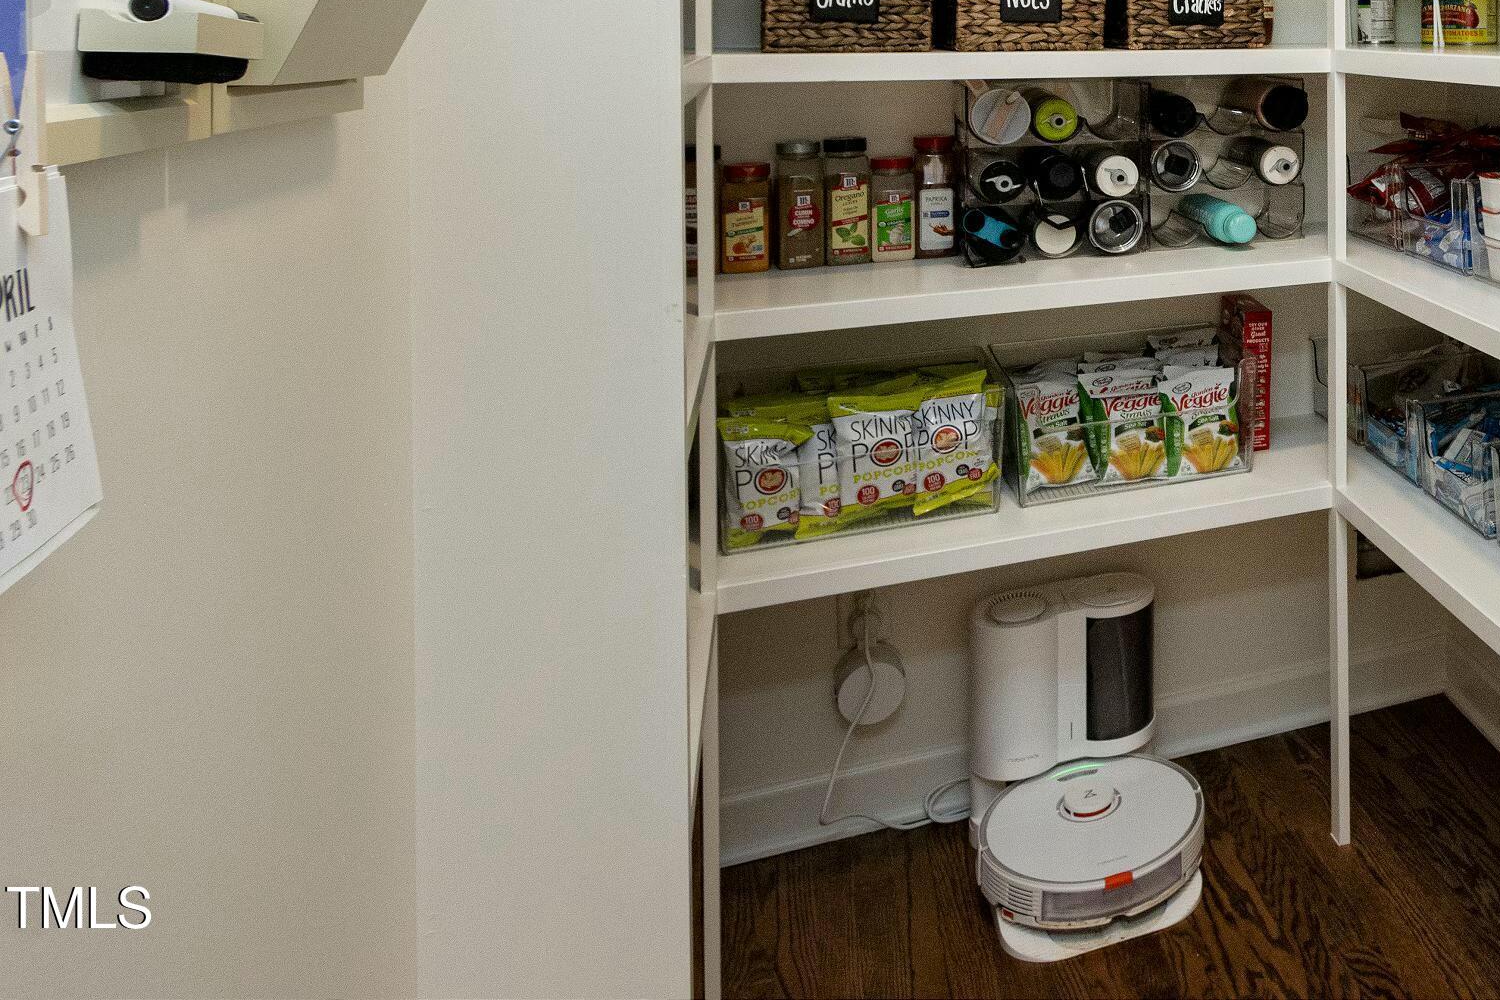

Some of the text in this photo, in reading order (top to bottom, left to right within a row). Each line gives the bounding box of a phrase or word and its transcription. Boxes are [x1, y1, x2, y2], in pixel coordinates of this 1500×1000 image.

[0, 267, 36, 322] RIL
[55, 379, 66, 397] 12
[1171, 386, 1229, 416] Veggie
[912, 400, 976, 430] SKINNY
[1019, 392, 1080, 420] Veggie
[1103, 394, 1162, 419] Veggie
[917, 419, 979, 461] POP
[861, 486, 876, 496] 100
